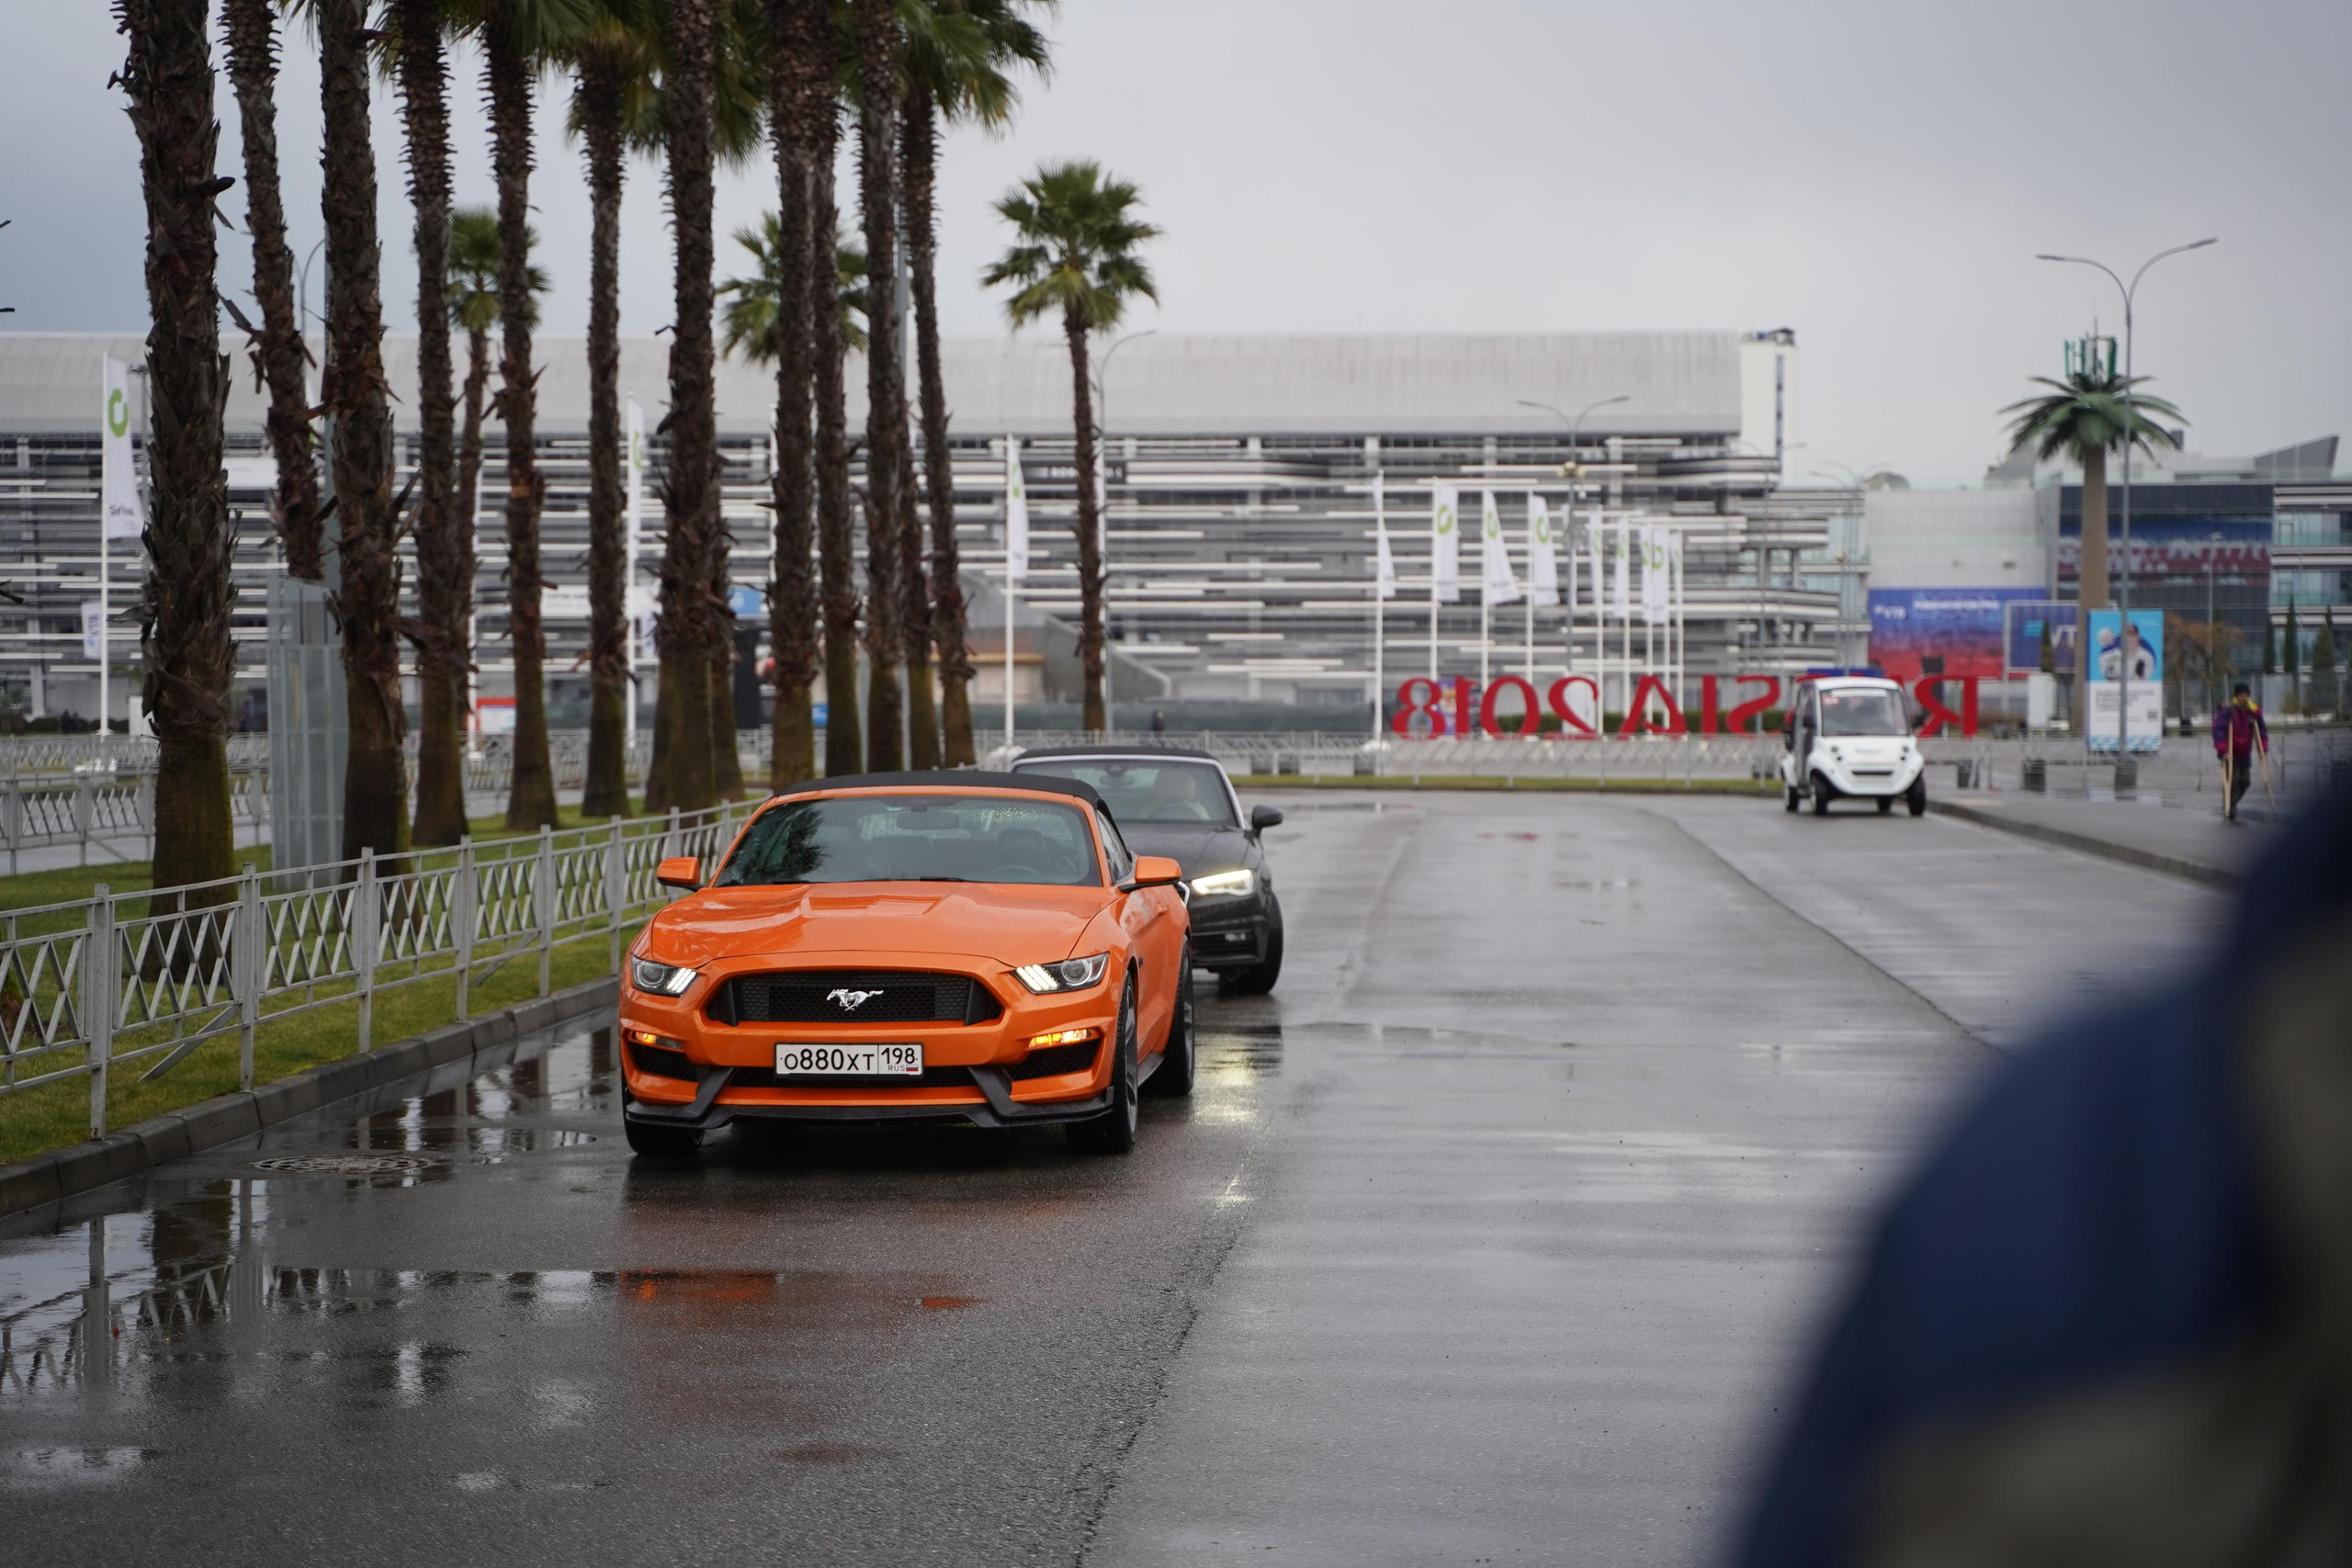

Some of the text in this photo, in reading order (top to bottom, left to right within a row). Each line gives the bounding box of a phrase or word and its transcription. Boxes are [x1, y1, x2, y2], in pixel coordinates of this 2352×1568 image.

[2051, 624, 2078, 648] VT
[786, 1047, 914, 1071] О880ХТ 198
